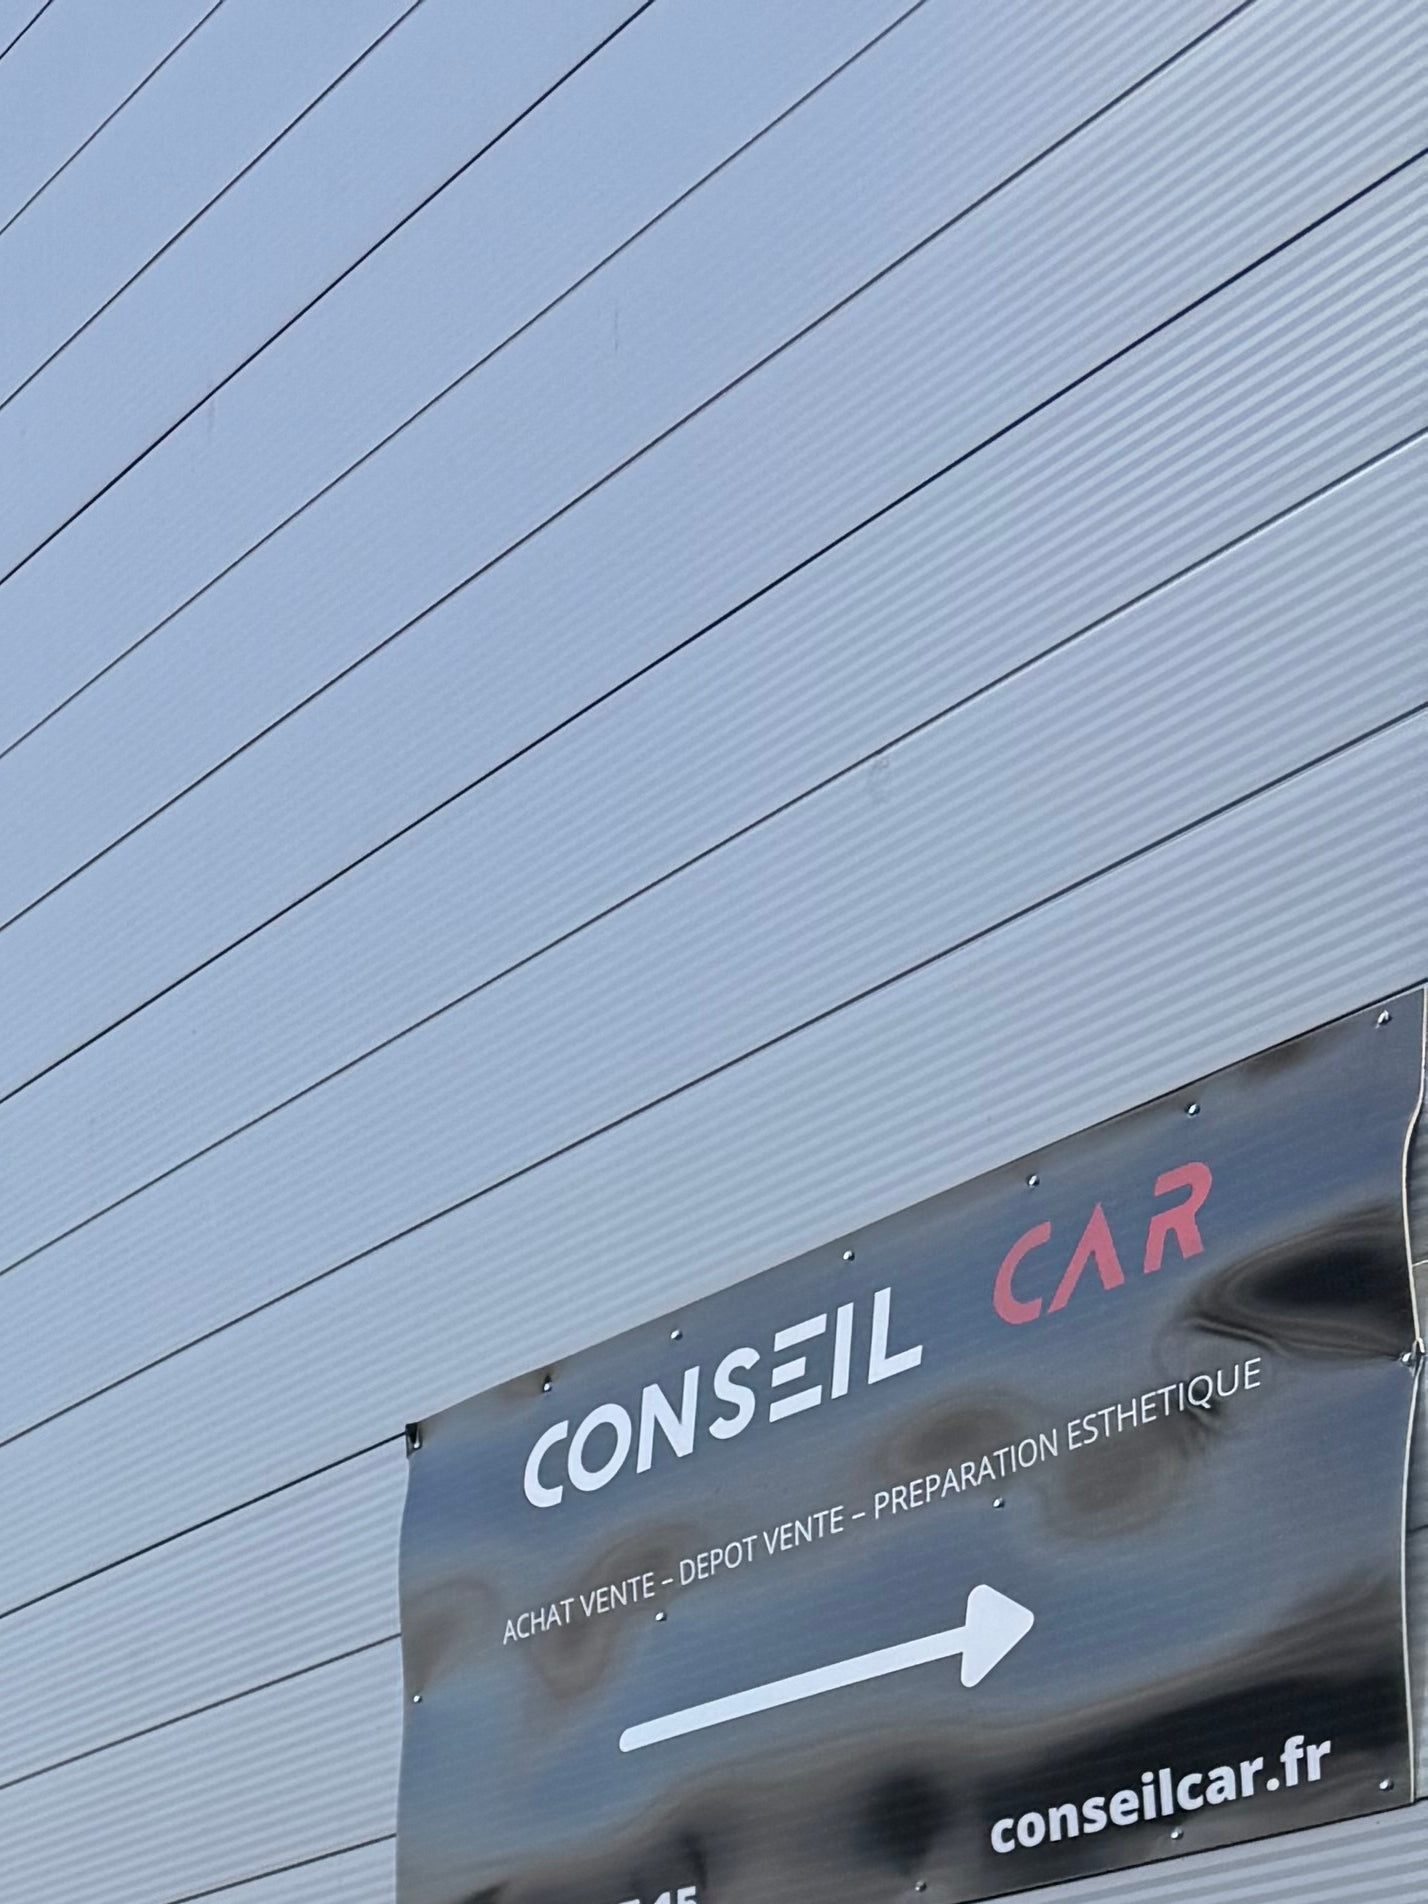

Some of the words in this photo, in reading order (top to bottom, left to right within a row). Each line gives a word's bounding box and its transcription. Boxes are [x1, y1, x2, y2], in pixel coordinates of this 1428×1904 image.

[523, 1287, 923, 1508] CONSEIL
[993, 1161, 1213, 1325] CAR
[503, 1598, 574, 1645] ACHAT
[580, 1572, 655, 1617] VENTE
[680, 1535, 757, 1586] DEPOT
[763, 1505, 844, 1555] VENTE
[874, 1429, 1058, 1519] PREPARATION
[1067, 1357, 1262, 1450] ESTHETIQUE
[990, 1735, 1331, 1853] conseilcar.fr
